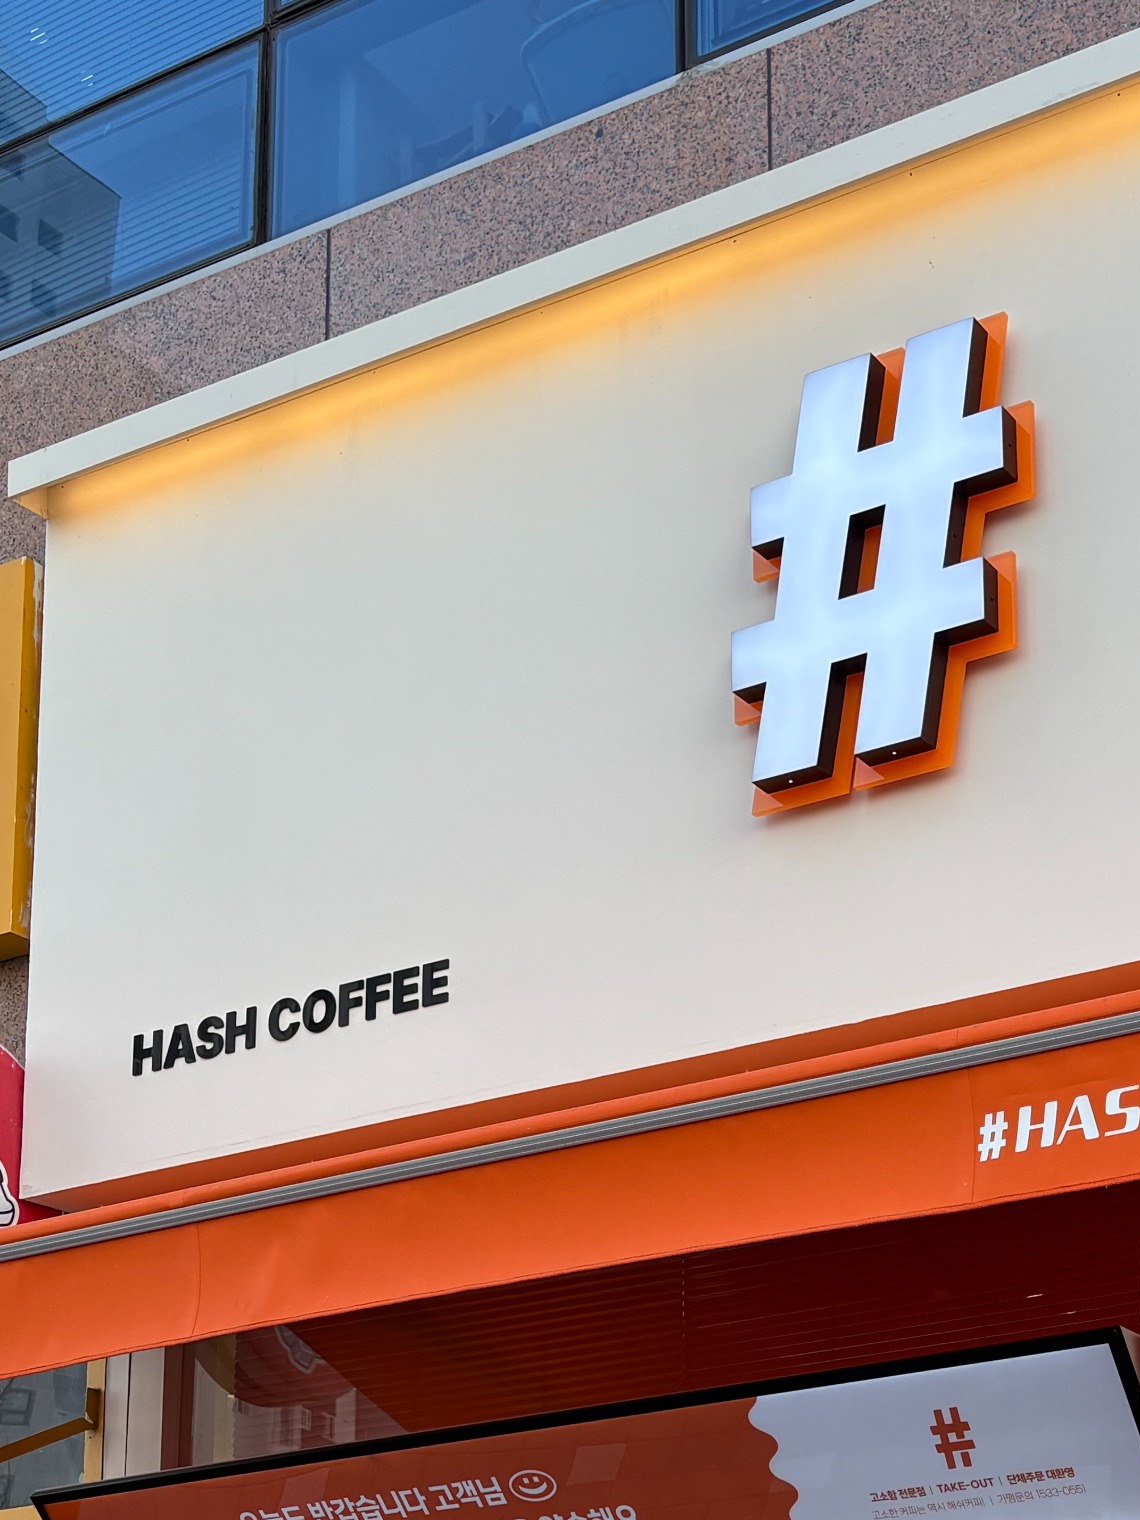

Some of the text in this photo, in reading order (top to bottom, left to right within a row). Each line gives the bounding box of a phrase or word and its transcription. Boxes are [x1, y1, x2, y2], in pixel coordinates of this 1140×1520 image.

[132, 959, 449, 1076] HASH COFFEE
[428, 1476, 507, 1512] 고객님
[898, 1486, 927, 1500] 전문점
[936, 1477, 994, 1494] TAKE-OUT
[1007, 1470, 1045, 1485] 단체주문
